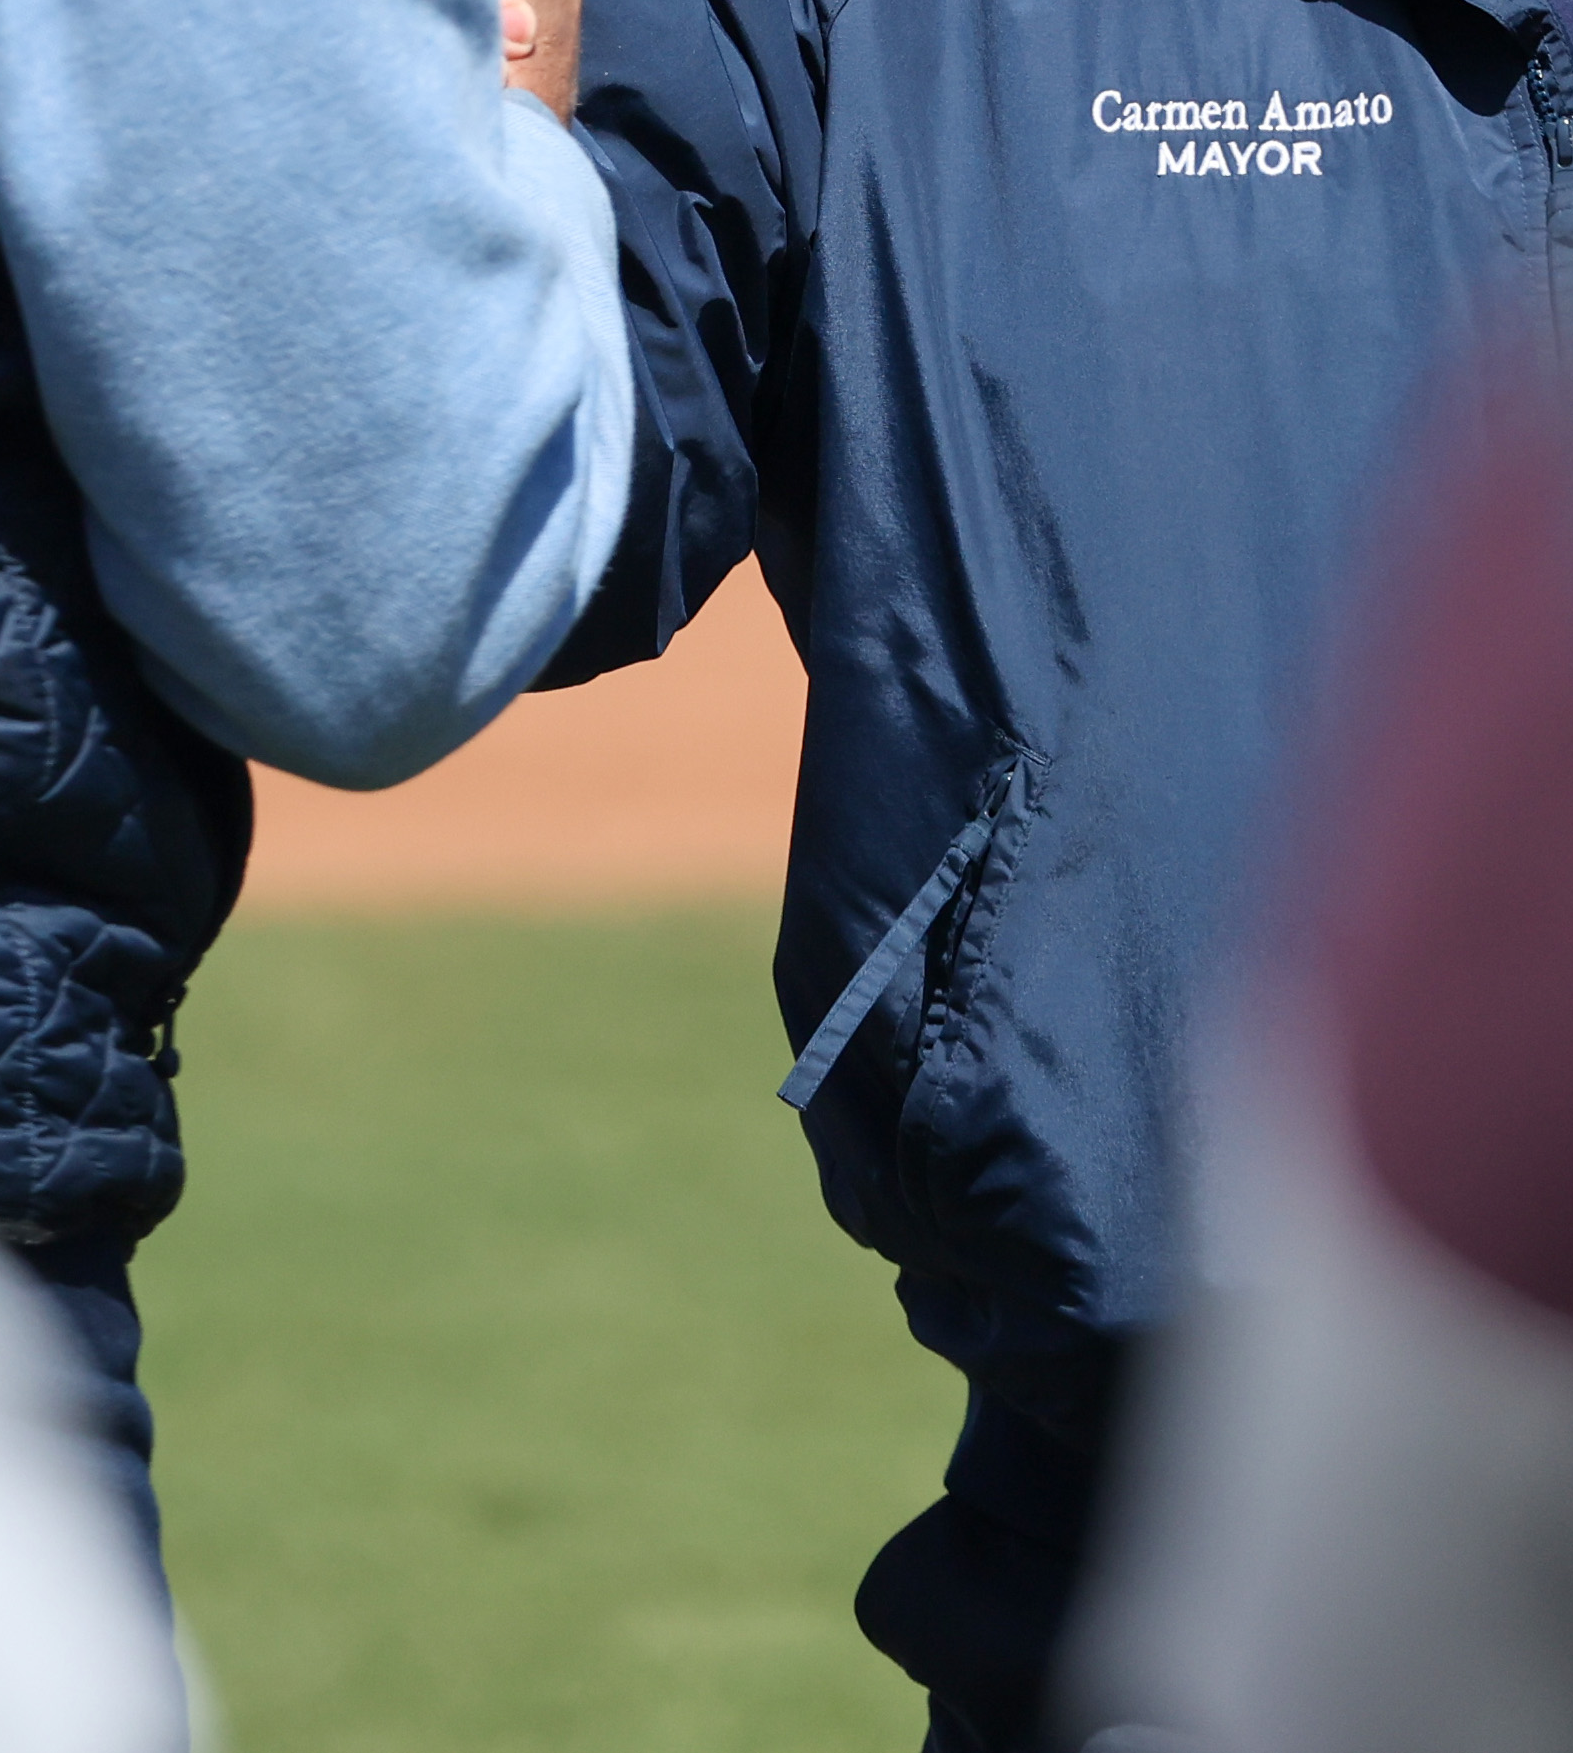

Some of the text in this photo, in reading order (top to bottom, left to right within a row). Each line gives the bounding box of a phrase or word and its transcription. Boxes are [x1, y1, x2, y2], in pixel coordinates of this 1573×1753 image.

[1092, 89, 1393, 133] Carmen Amato
[1156, 140, 1323, 177] MAYOR
